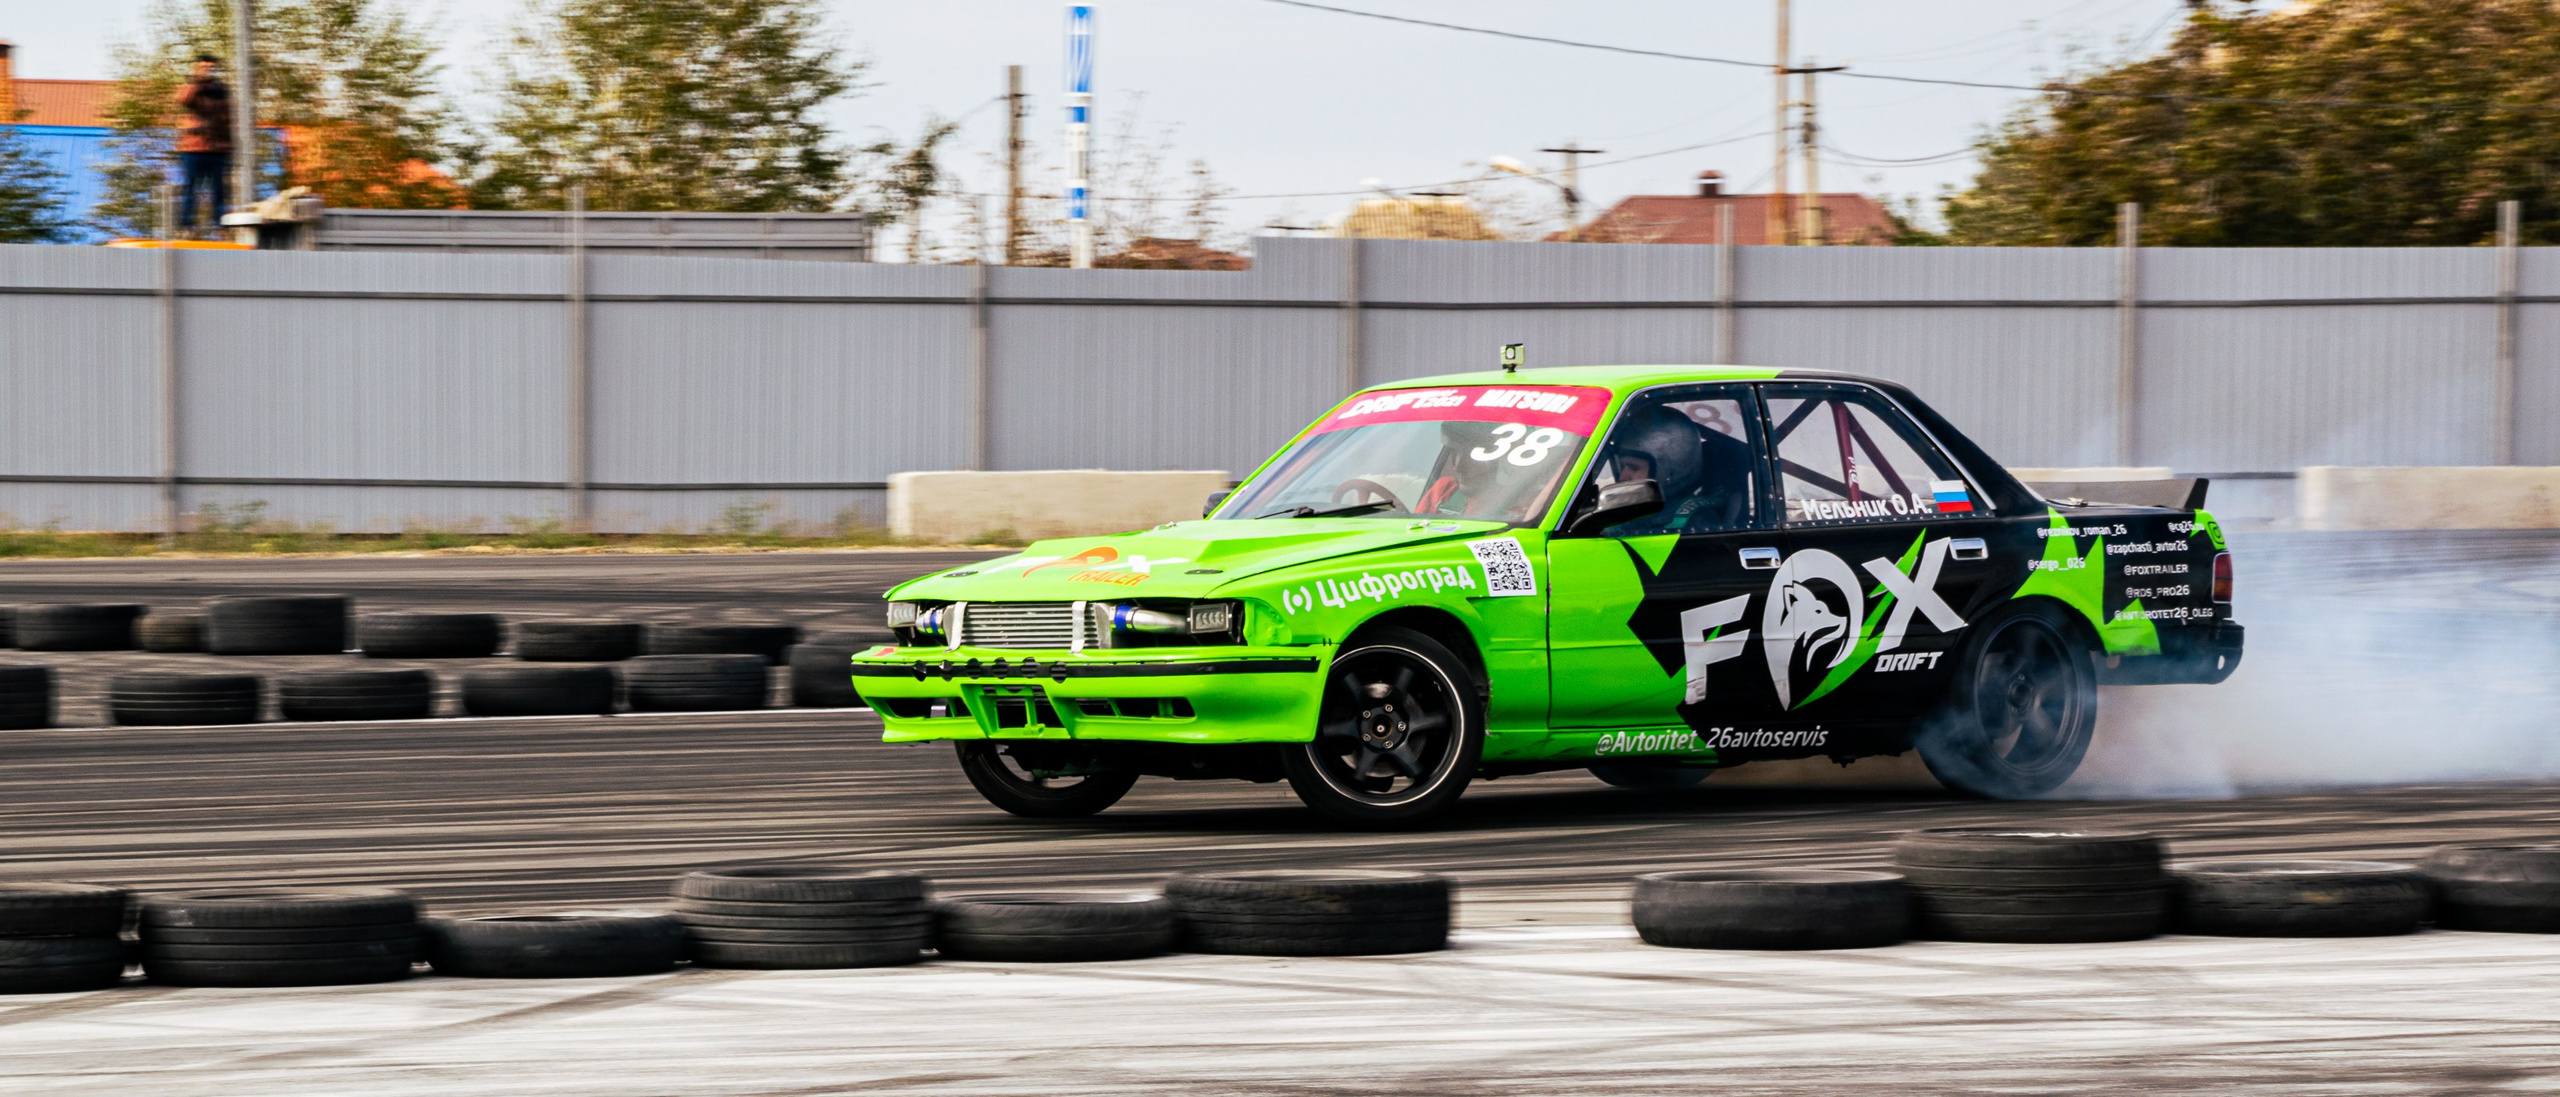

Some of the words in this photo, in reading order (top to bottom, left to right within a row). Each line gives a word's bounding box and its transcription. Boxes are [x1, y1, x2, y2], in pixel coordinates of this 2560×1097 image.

[1338, 390, 1432, 420] DRIFT
[1474, 389, 1578, 414] MATSURI
[1470, 422, 1563, 467] 38
[1800, 498, 1891, 521] Мельник
[2105, 540, 2189, 556] @zapchasti_avtor26
[1066, 570, 1152, 587] TRAILER
[2123, 563, 2189, 576] @FOXTRAILER
[1315, 564, 1476, 609] Цифроград
[2125, 584, 2190, 600] @RDS_PRO26
[1680, 537, 1968, 711] FOX
[1874, 651, 1944, 673] DRIFT
[1594, 725, 1829, 756] @Avtoritet_26avtoservis
